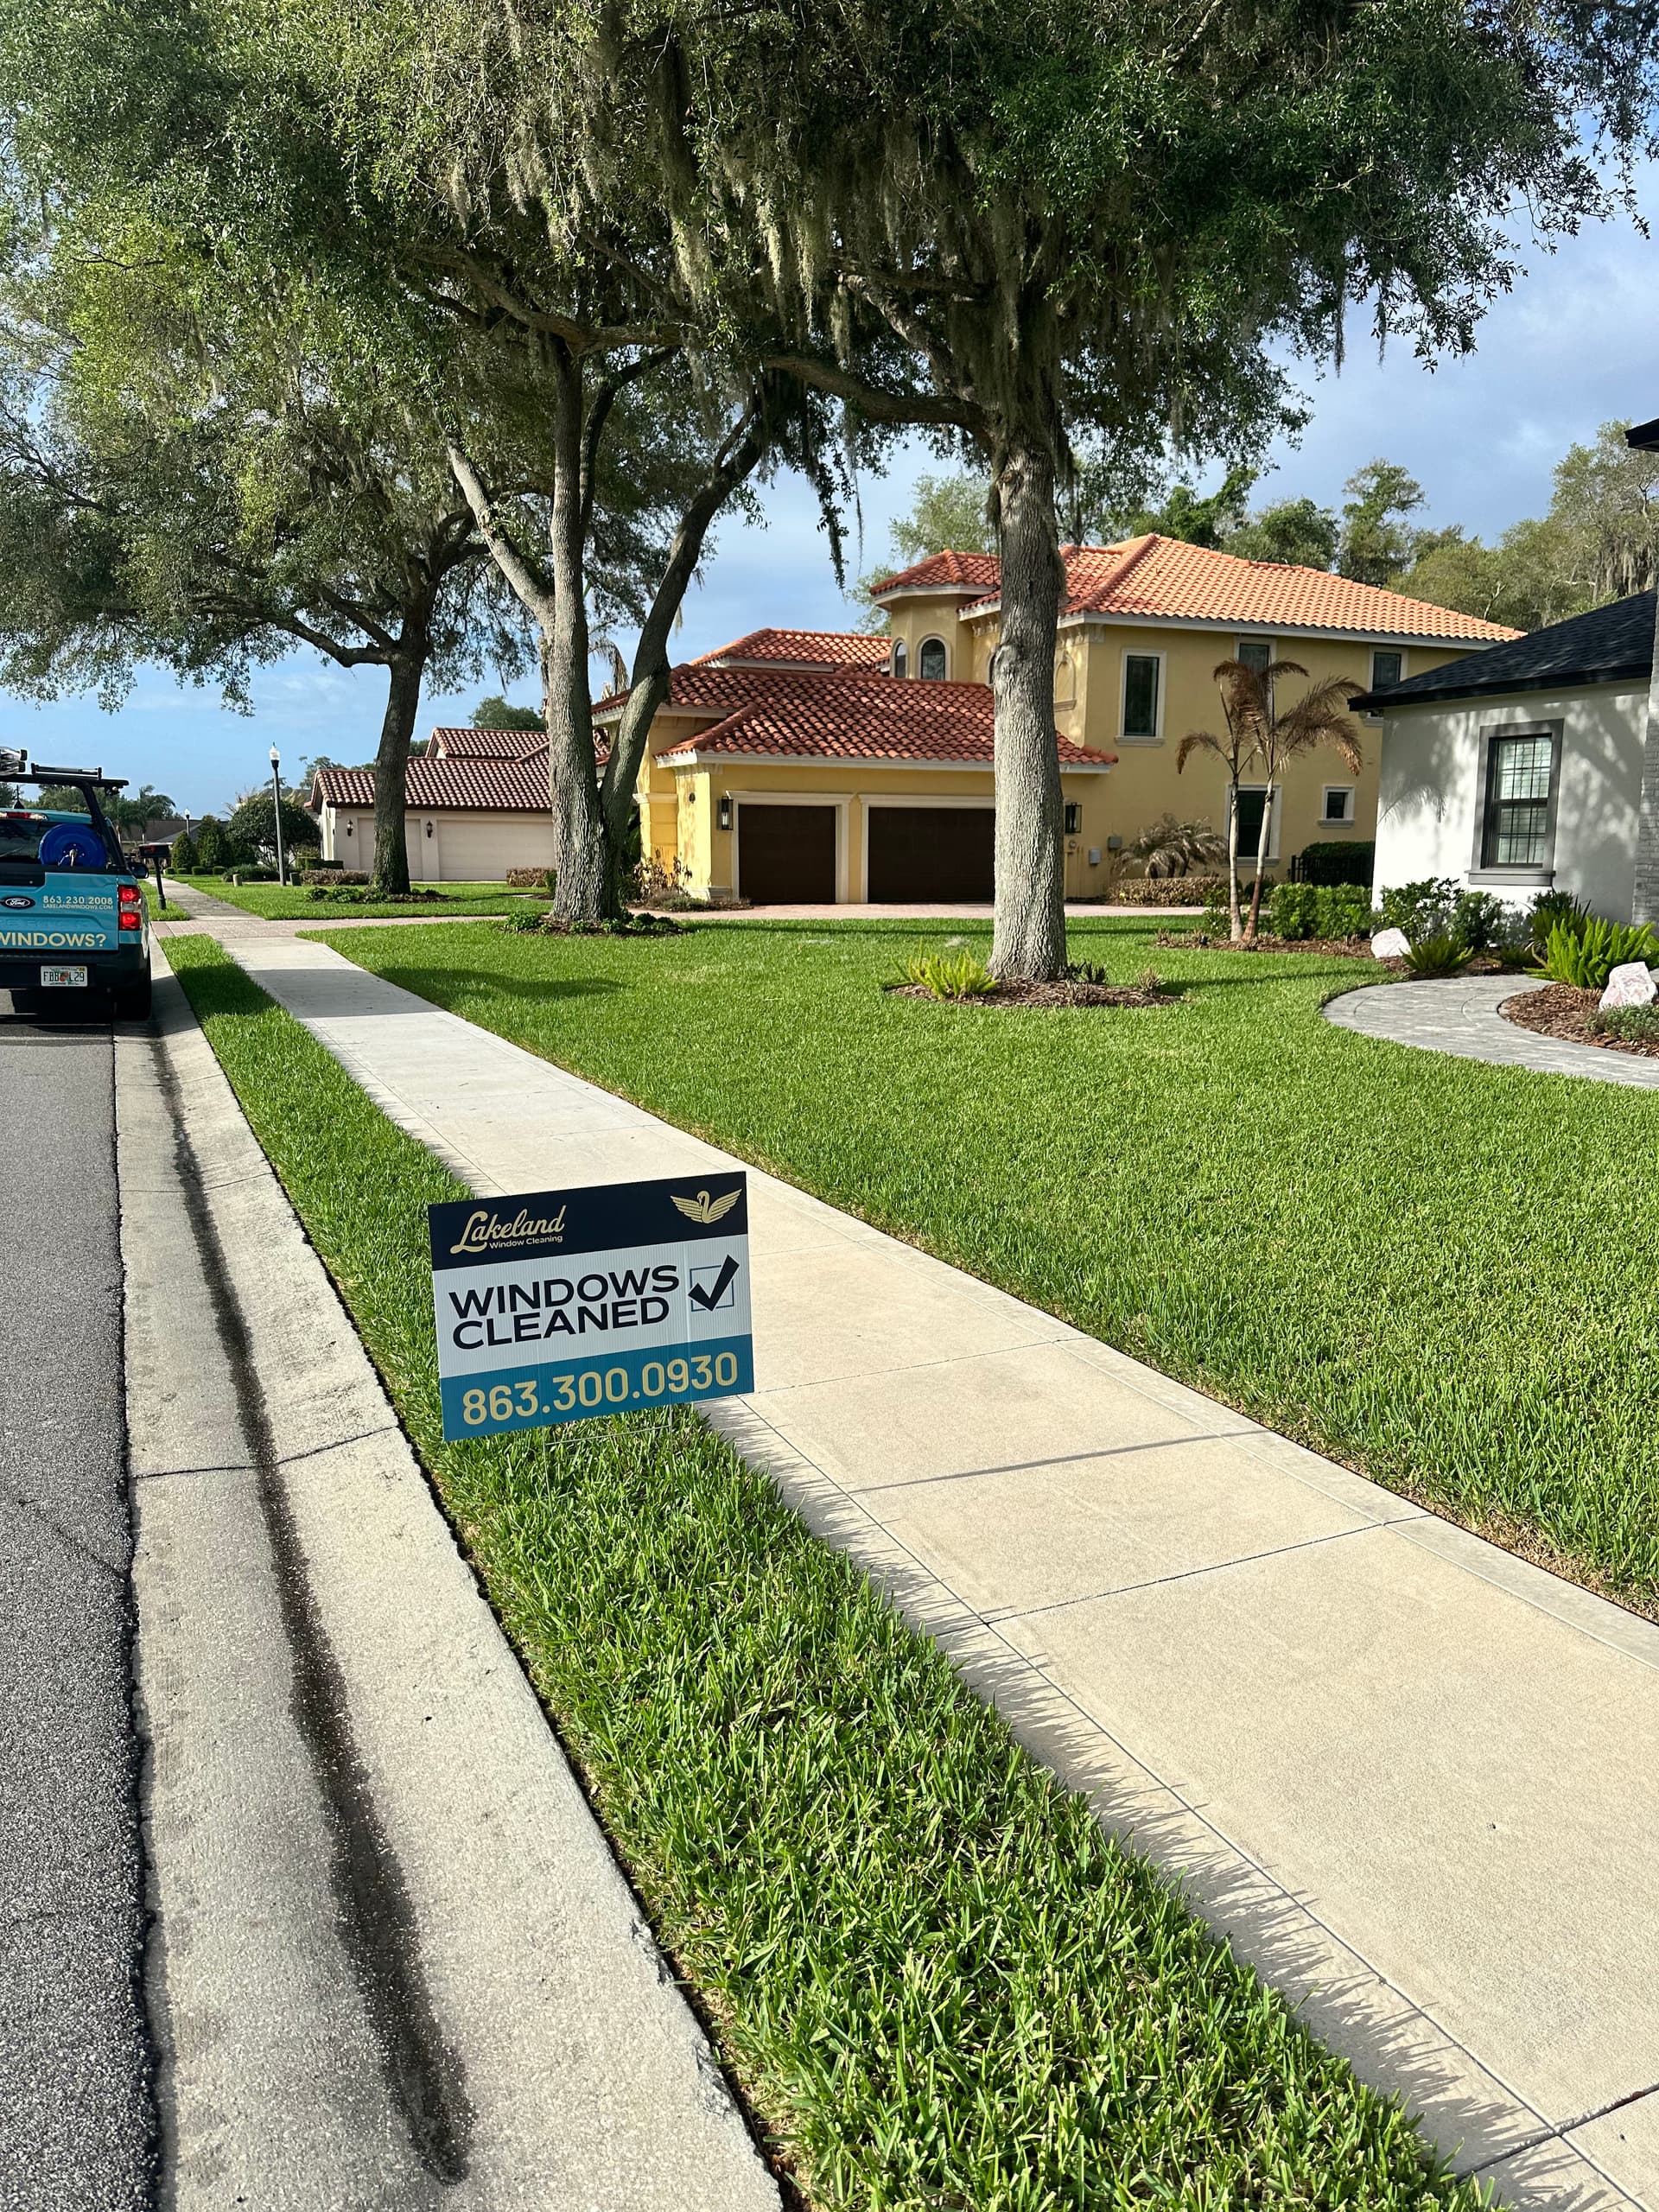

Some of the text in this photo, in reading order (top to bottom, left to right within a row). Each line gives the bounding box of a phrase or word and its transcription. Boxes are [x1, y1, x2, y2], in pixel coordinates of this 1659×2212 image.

[42, 895, 113, 905] 863.230.2008
[450, 1205, 567, 1254] Lakeland
[489, 1235, 563, 1249] Window Cleaning
[448, 1265, 680, 1319] WINDOWS
[452, 1296, 670, 1350] CLEANED
[461, 1351, 739, 1426] 863.300.0930
